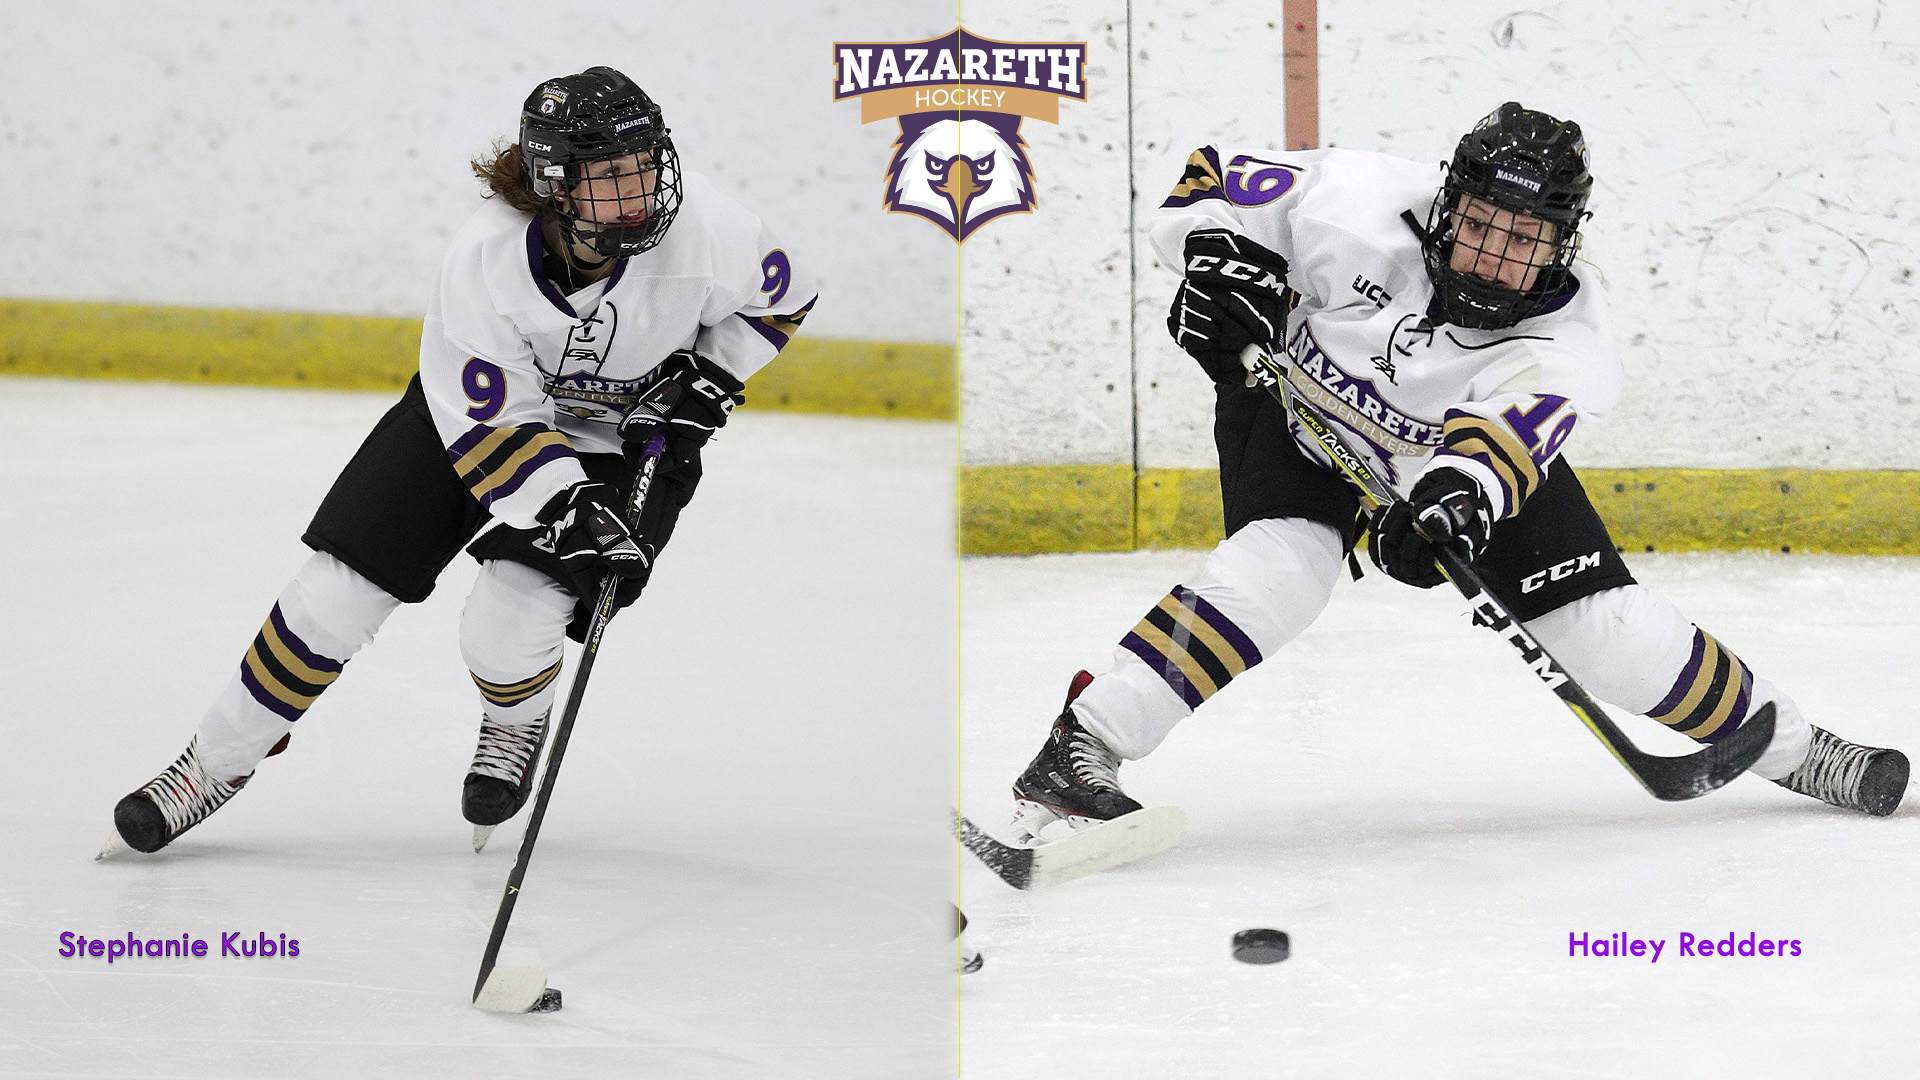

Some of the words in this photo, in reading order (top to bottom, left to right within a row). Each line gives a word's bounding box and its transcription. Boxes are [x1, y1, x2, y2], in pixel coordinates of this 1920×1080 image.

[528, 141, 552, 152] CCM
[614, 115, 651, 133] NAZARETH
[1495, 168, 1542, 194] NAZARETH
[759, 248, 792, 309] 9
[1187, 255, 1287, 297] CCM
[461, 355, 508, 423] 9
[1289, 325, 1444, 448] NAZARETH
[629, 418, 657, 427] CCM
[1297, 374, 1360, 430] GOLDEN
[1361, 422, 1417, 457] FLYERS
[1297, 407, 1323, 433] SUPER
[1320, 427, 1360, 472] TACKS
[1500, 393, 1578, 470] 19
[611, 554, 639, 562] CCM
[1520, 551, 1600, 594] CCM
[1468, 588, 1569, 690] CCM
